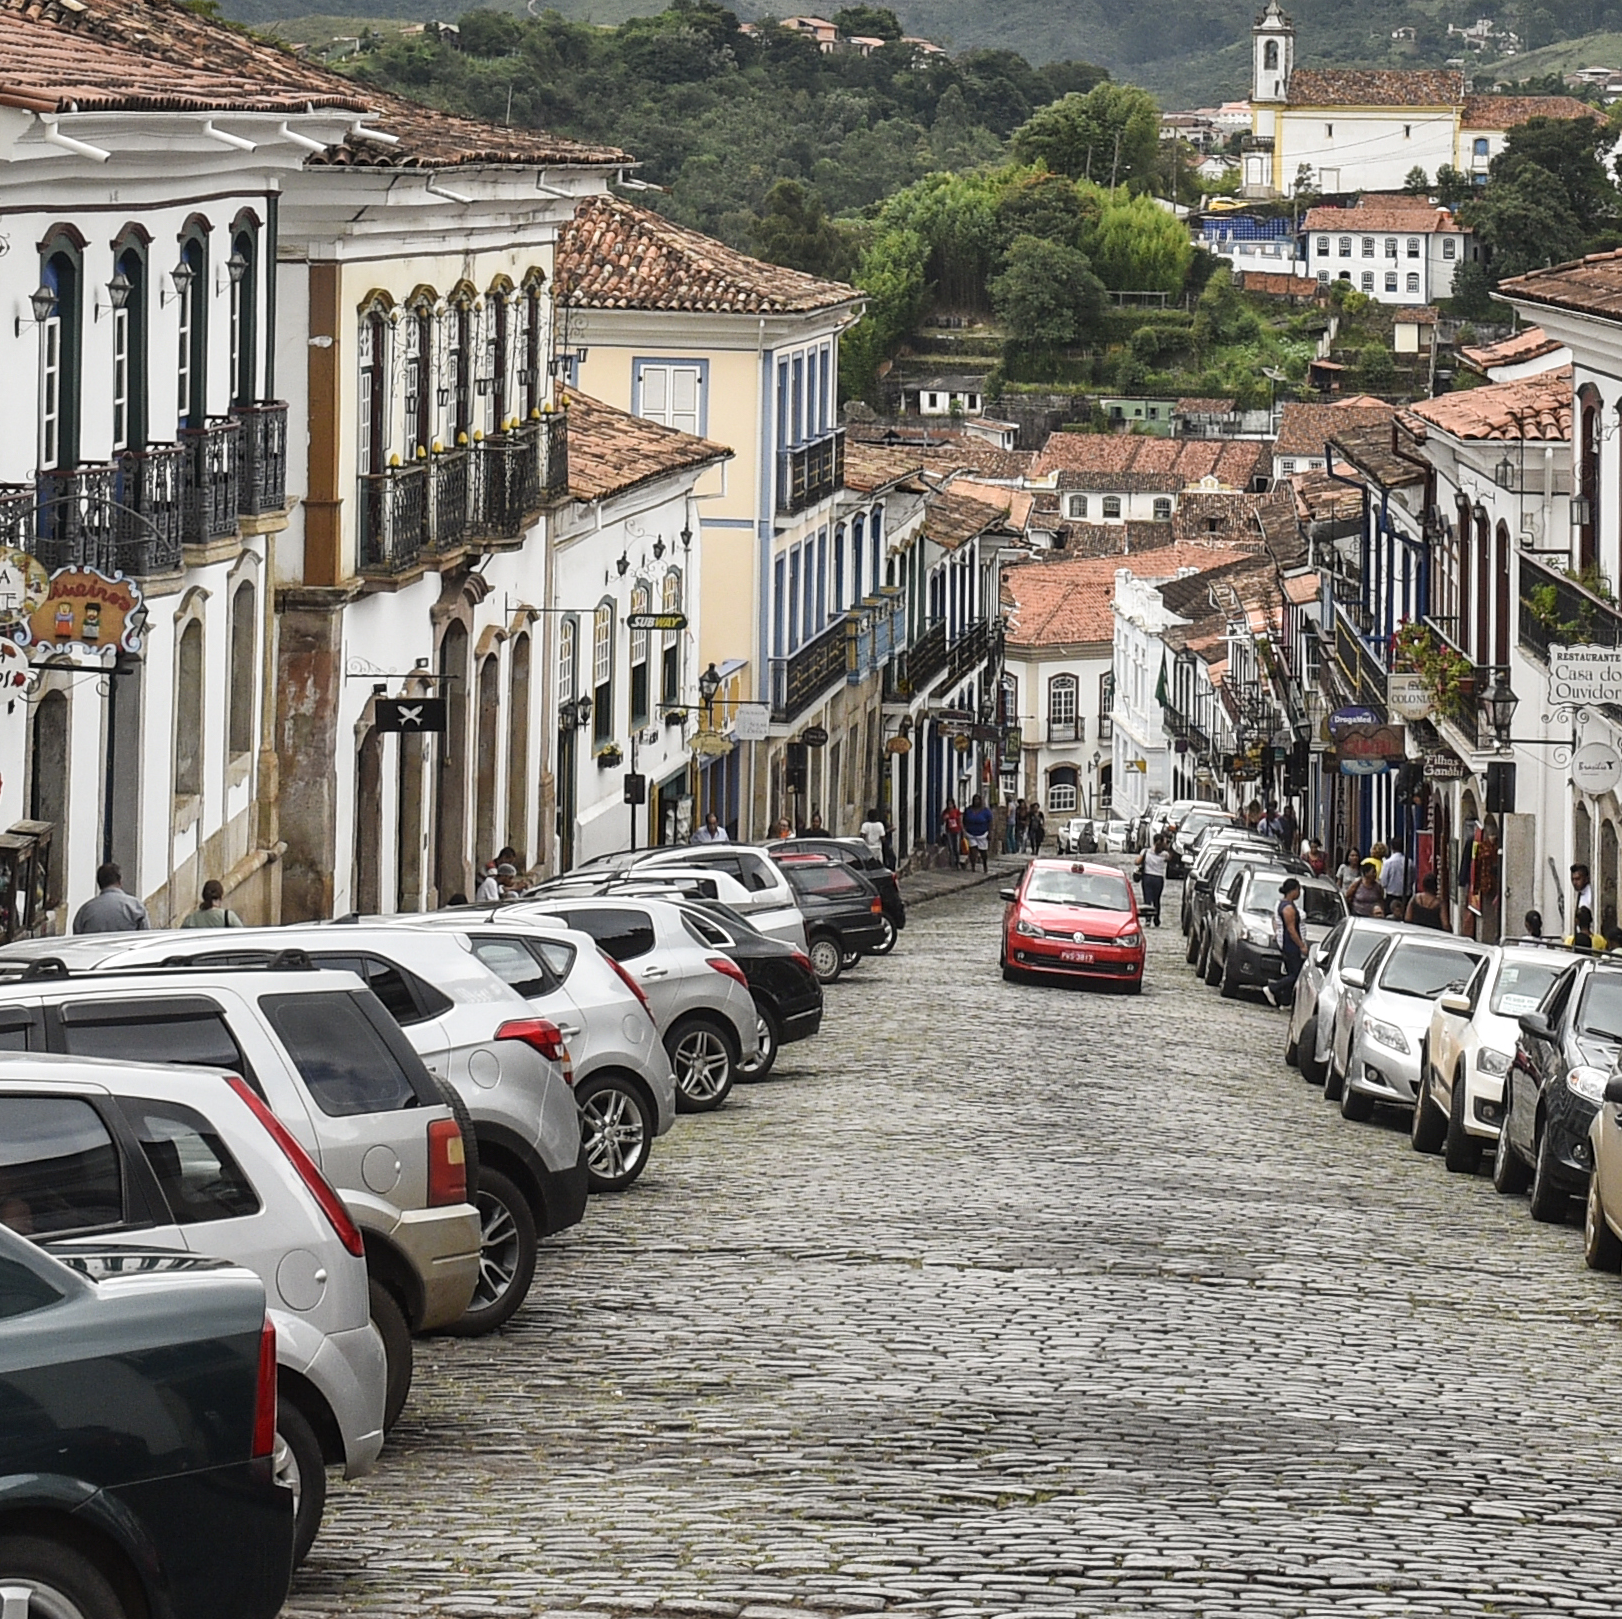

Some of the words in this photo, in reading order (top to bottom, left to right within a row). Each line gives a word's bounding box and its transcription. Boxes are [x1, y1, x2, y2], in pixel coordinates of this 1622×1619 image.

[48, 579, 131, 611] ineiros
[631, 616, 683, 628] SUBWAY
[1557, 652, 1621, 663] RESTAURANTE
[1555, 664, 1593, 681] Casa
[1600, 665, 1622, 682] do
[1556, 682, 1622, 700] Ouvidor
[1392, 694, 1438, 705] COLONIA
[1334, 714, 1372, 726] DrogaMed
